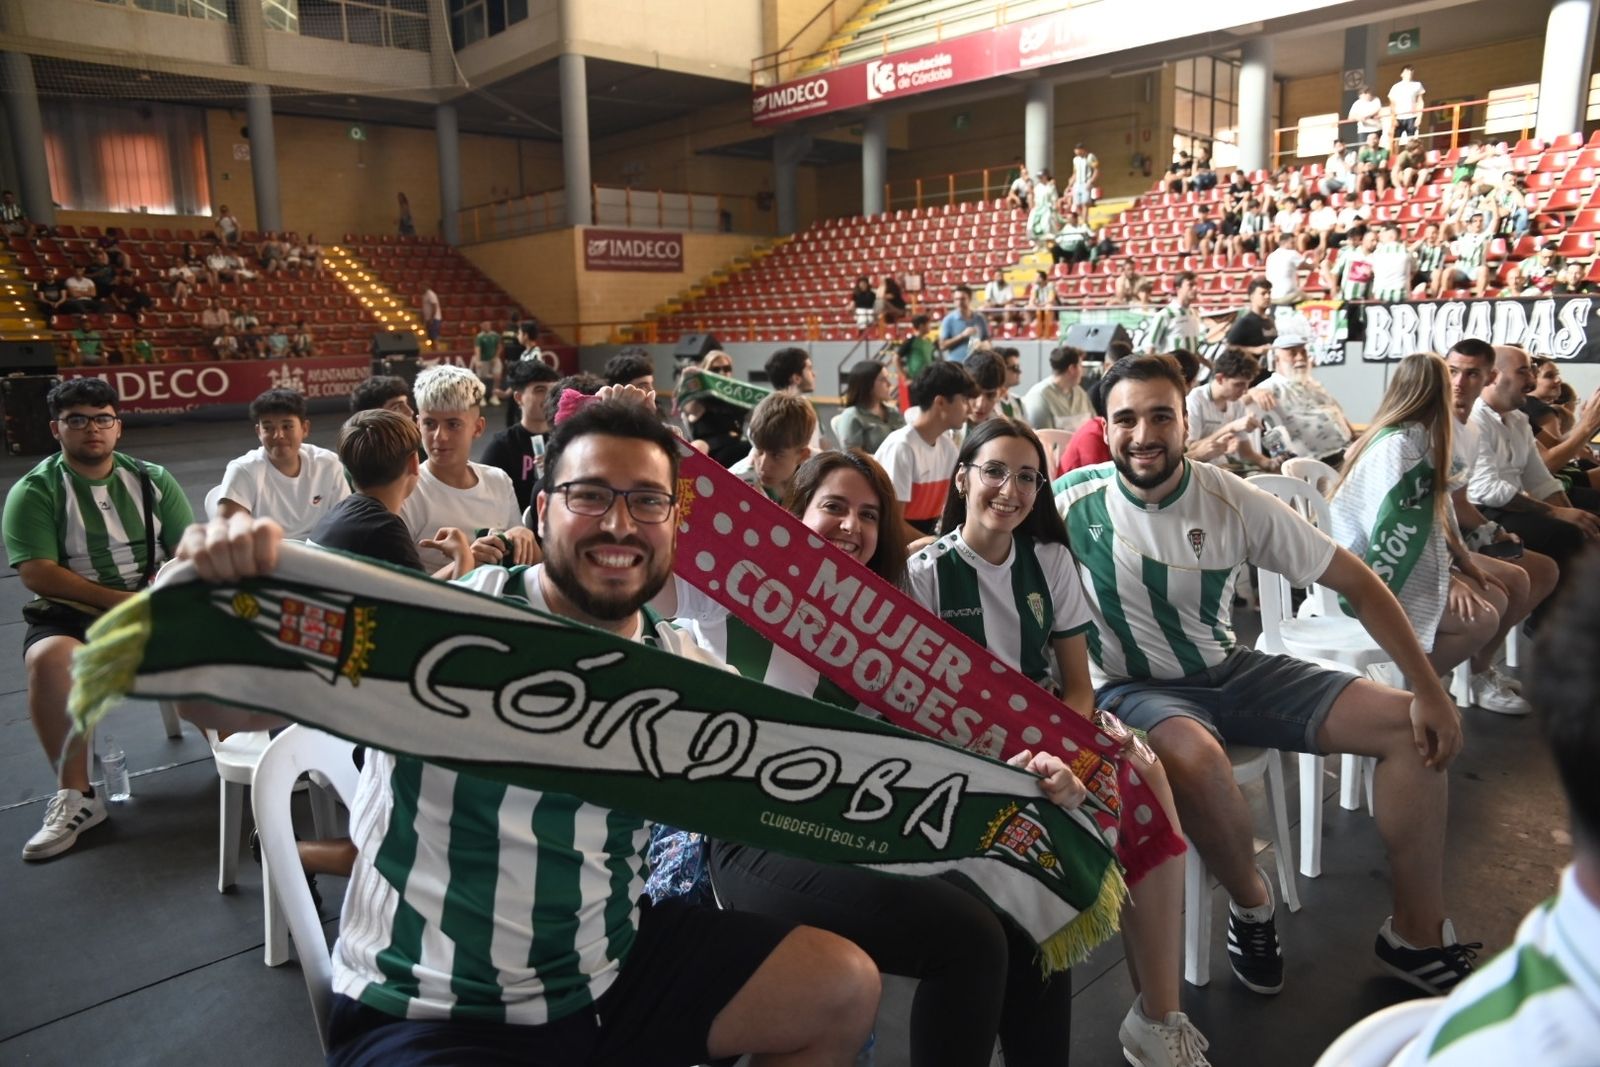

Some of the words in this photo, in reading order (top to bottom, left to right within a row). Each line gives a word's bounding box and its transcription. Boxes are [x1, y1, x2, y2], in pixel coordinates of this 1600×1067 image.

[897, 53, 952, 76] Diputación
[898, 76, 910, 89] de
[912, 68, 953, 86] Córdoba
[769, 79, 828, 109] IMDECO
[610, 240, 680, 258] IMDECO
[1364, 298, 1592, 360] BRIGADAS
[58, 367, 229, 401] DECO
[308, 366, 370, 382] AYUNTAMIENT
[807, 558, 972, 693] MUJER
[726, 559, 1008, 759] CORDOBESA
[409, 633, 969, 851] CÓRDOBA
